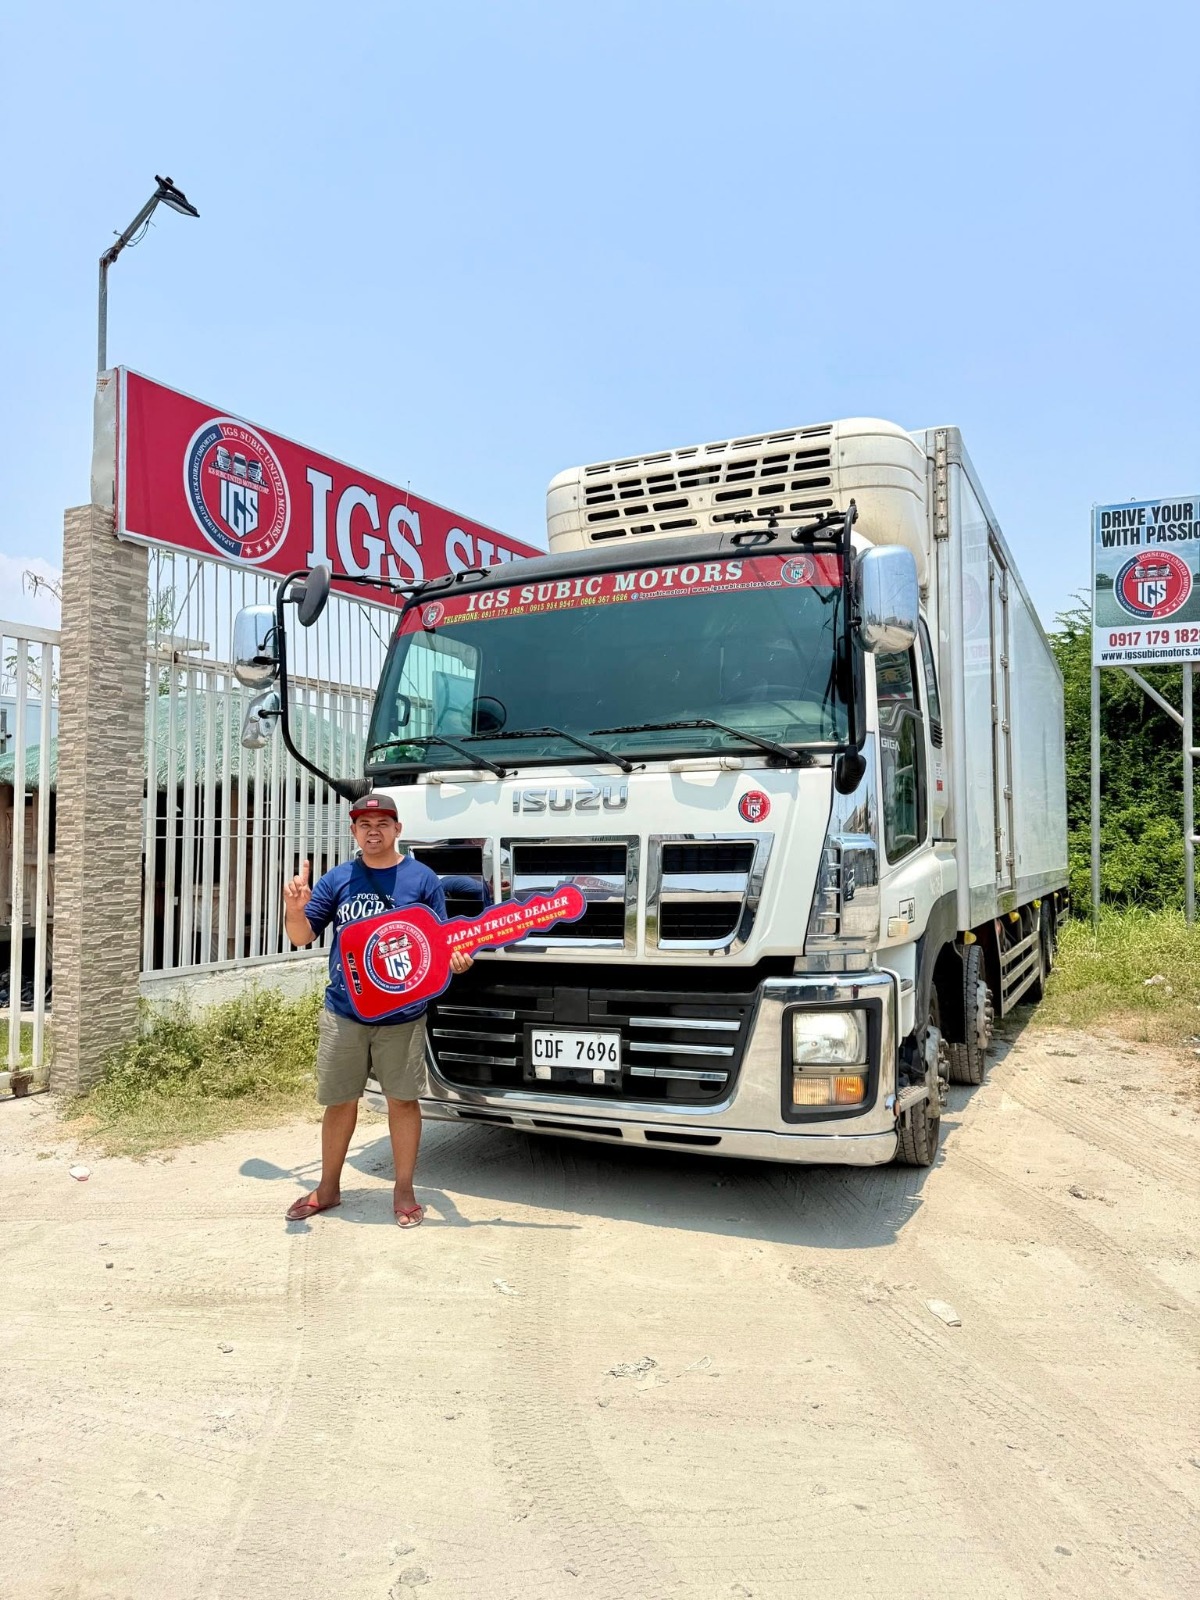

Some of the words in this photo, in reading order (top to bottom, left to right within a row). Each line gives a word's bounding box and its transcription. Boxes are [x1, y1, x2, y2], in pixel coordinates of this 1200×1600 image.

[196, 433, 217, 458] IMPORTER
[222, 427, 239, 438] IGS
[240, 431, 266, 456] SUBIC
[265, 457, 284, 495] UNITED
[220, 480, 260, 538] IGS
[272, 495, 286, 539] MOTORS
[1101, 507, 1146, 529] DRIVE
[1151, 502, 1193, 524] YOUR
[306, 466, 425, 600] IGS
[1101, 527, 1140, 548] WITH
[1171, 557, 1188, 578] UNITED
[466, 589, 510, 612] IGS
[519, 576, 604, 604] SUBIC
[613, 561, 743, 592] MOTORS
[691, 580, 782, 594] www.igssubicmotors.com
[1137, 580, 1167, 608] IGS
[1179, 577, 1189, 602] MOTORS
[1109, 631, 1141, 647] 0917
[1146, 629, 1170, 645] 179
[1174, 628, 1200, 644] 182
[881, 737, 901, 752] GIGA
[512, 786, 629, 813] ISUZU
[747, 804, 761, 819] IGS
[446, 924, 482, 945] JAPAN
[484, 909, 522, 931] TRUCK
[524, 896, 569, 918] DEALER
[453, 941, 474, 952] DRIVE
[477, 934, 494, 944] YOUR
[497, 927, 514, 937] PATH
[517, 920, 535, 930] WITH
[537, 910, 567, 924] PASSION
[384, 949, 413, 981] IGS
[534, 1038, 564, 1059] CDF
[576, 1041, 617, 1062] 7696
